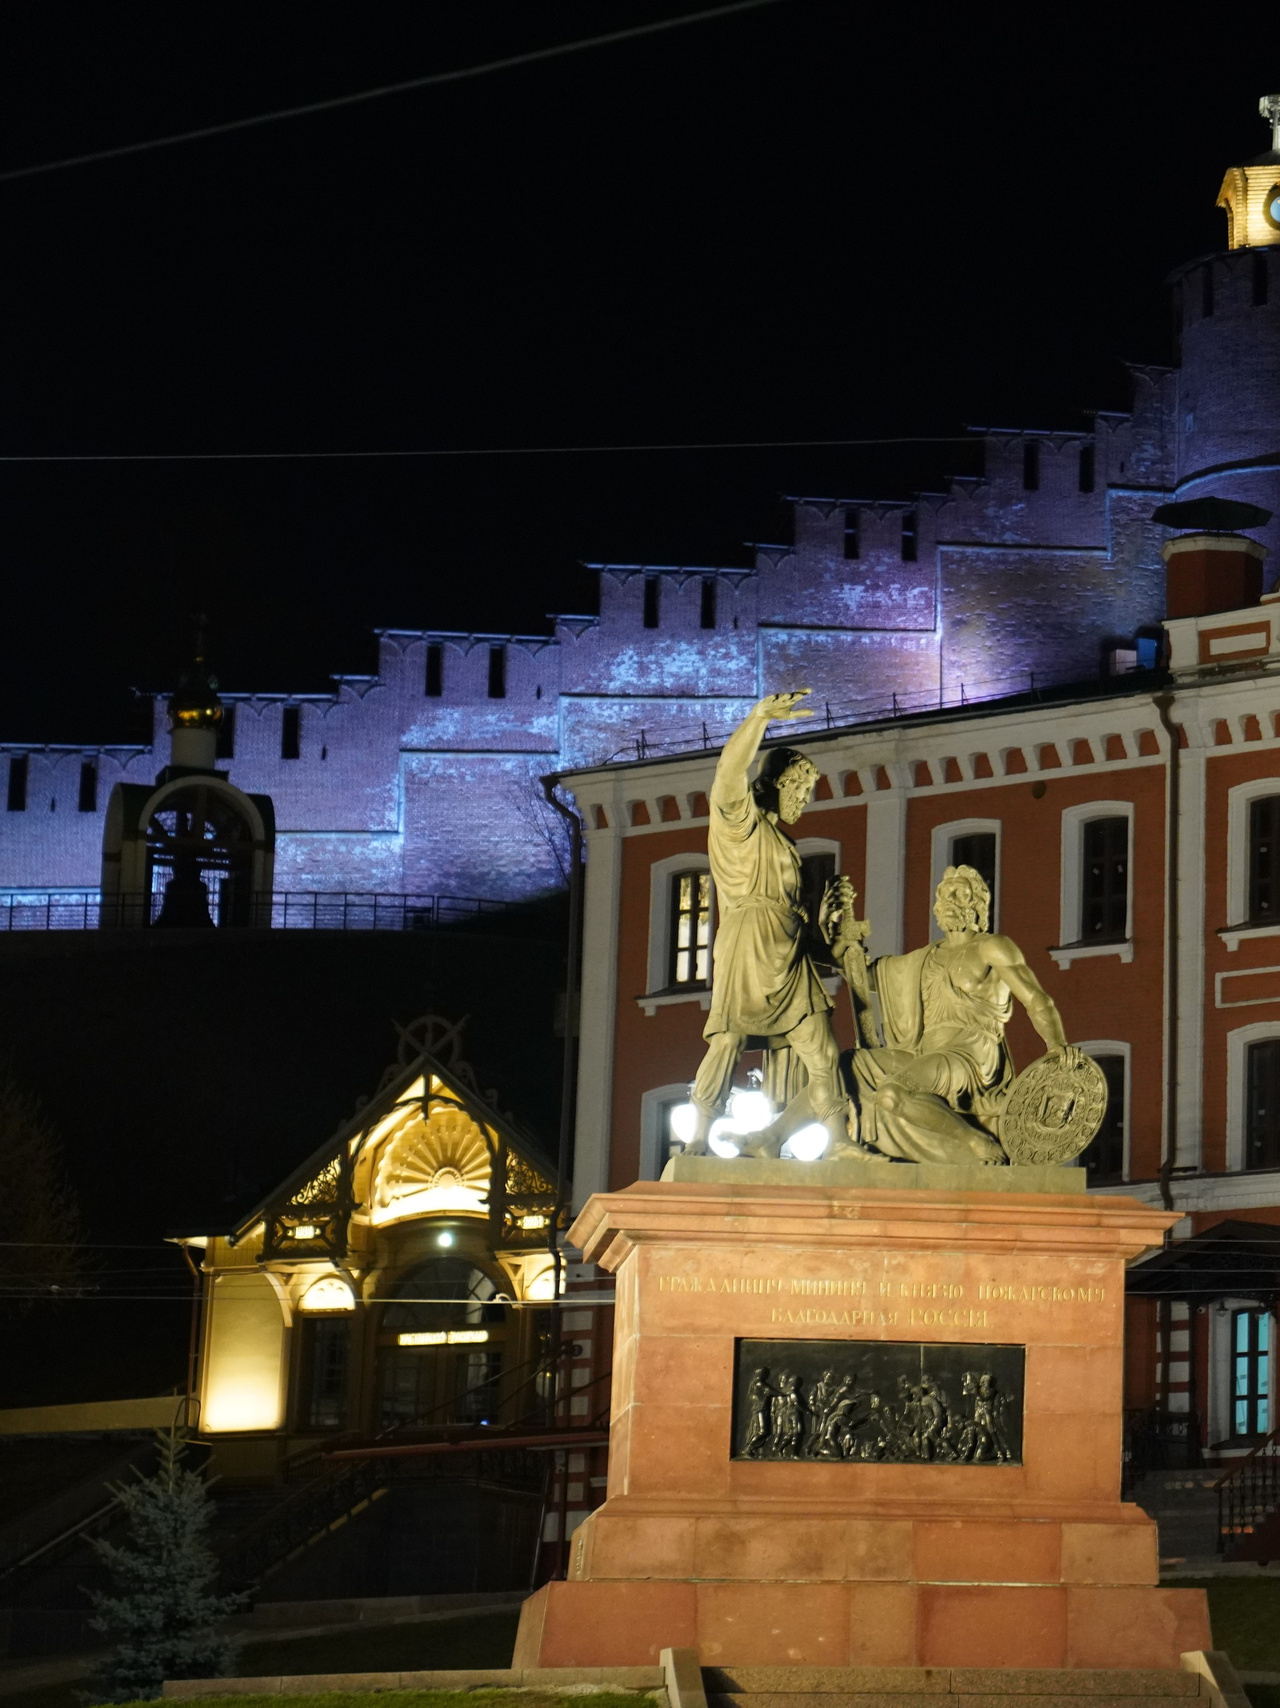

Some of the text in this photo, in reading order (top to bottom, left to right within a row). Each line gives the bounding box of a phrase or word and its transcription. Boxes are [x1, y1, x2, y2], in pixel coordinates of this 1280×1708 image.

[878, 1281, 891, 1298] И
[977, 1284, 1106, 1303] ПОЖАРСКОМУ
[770, 1307, 898, 1327] БЛАГОДАРНАЯ
